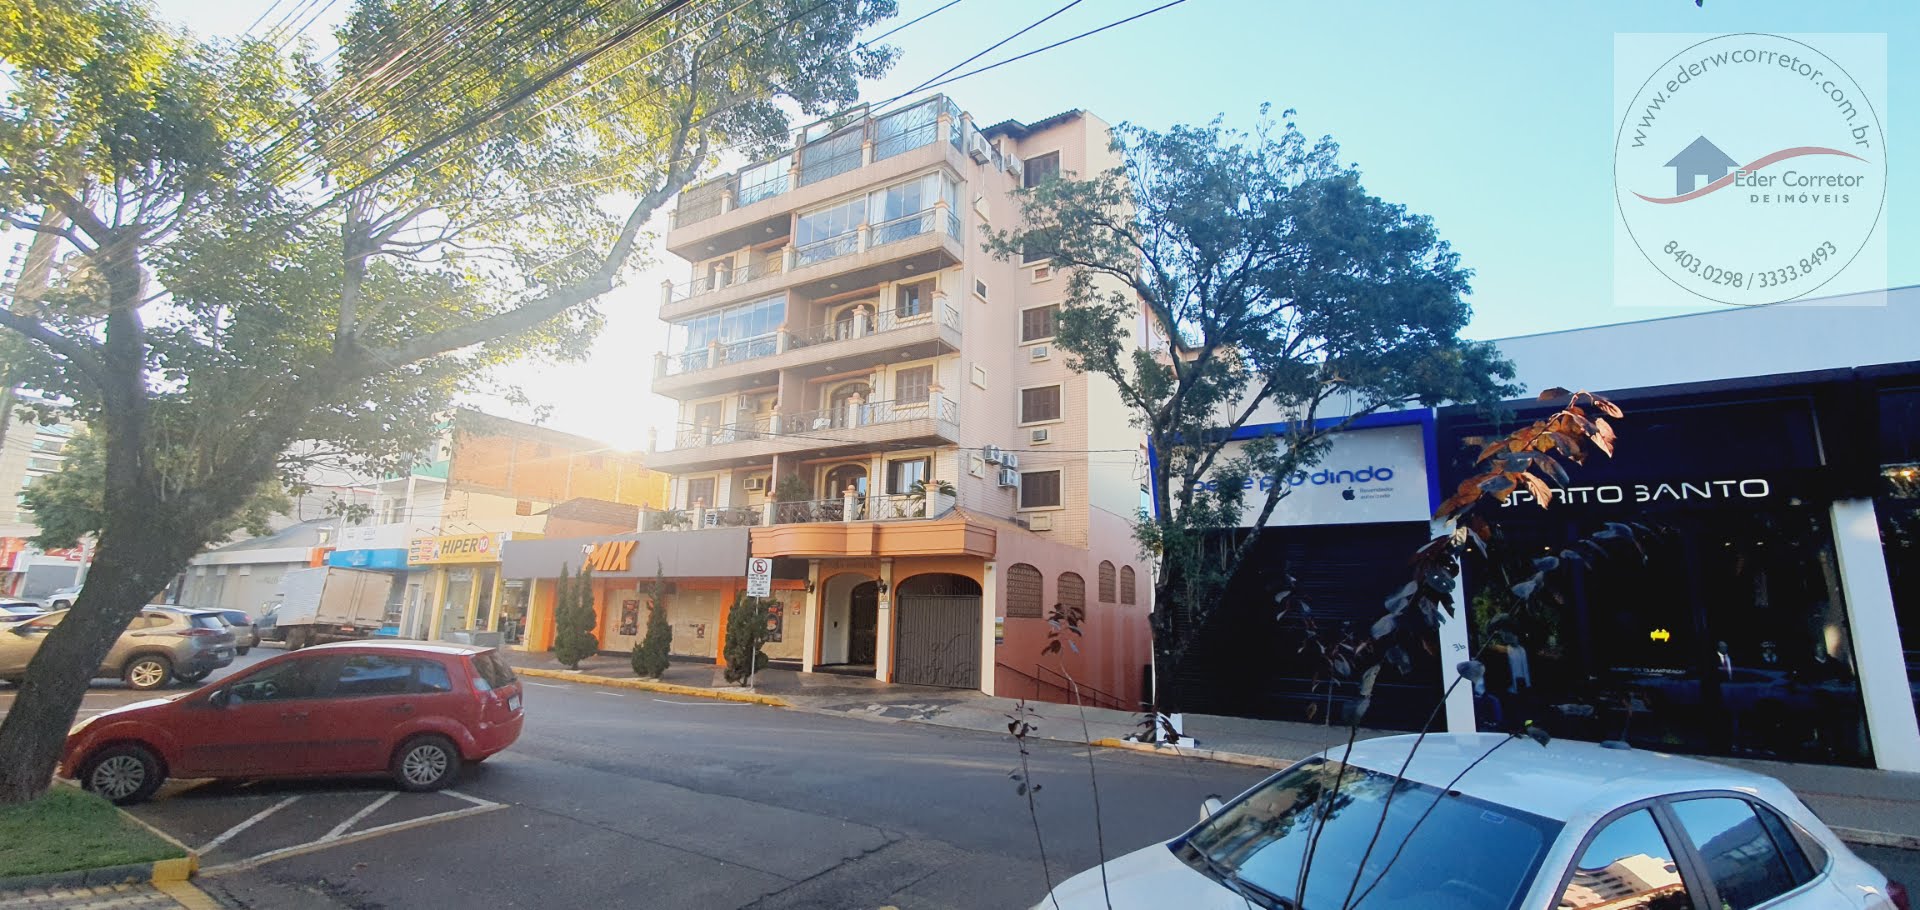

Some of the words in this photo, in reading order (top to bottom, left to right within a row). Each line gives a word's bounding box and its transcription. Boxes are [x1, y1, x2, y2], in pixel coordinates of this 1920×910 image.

[1260, 472, 1305, 492] po
[1311, 465, 1393, 485] dindo
[1635, 479, 1769, 502] SANTO
[441, 538, 479, 555] HIPER
[581, 540, 639, 572] MIX
